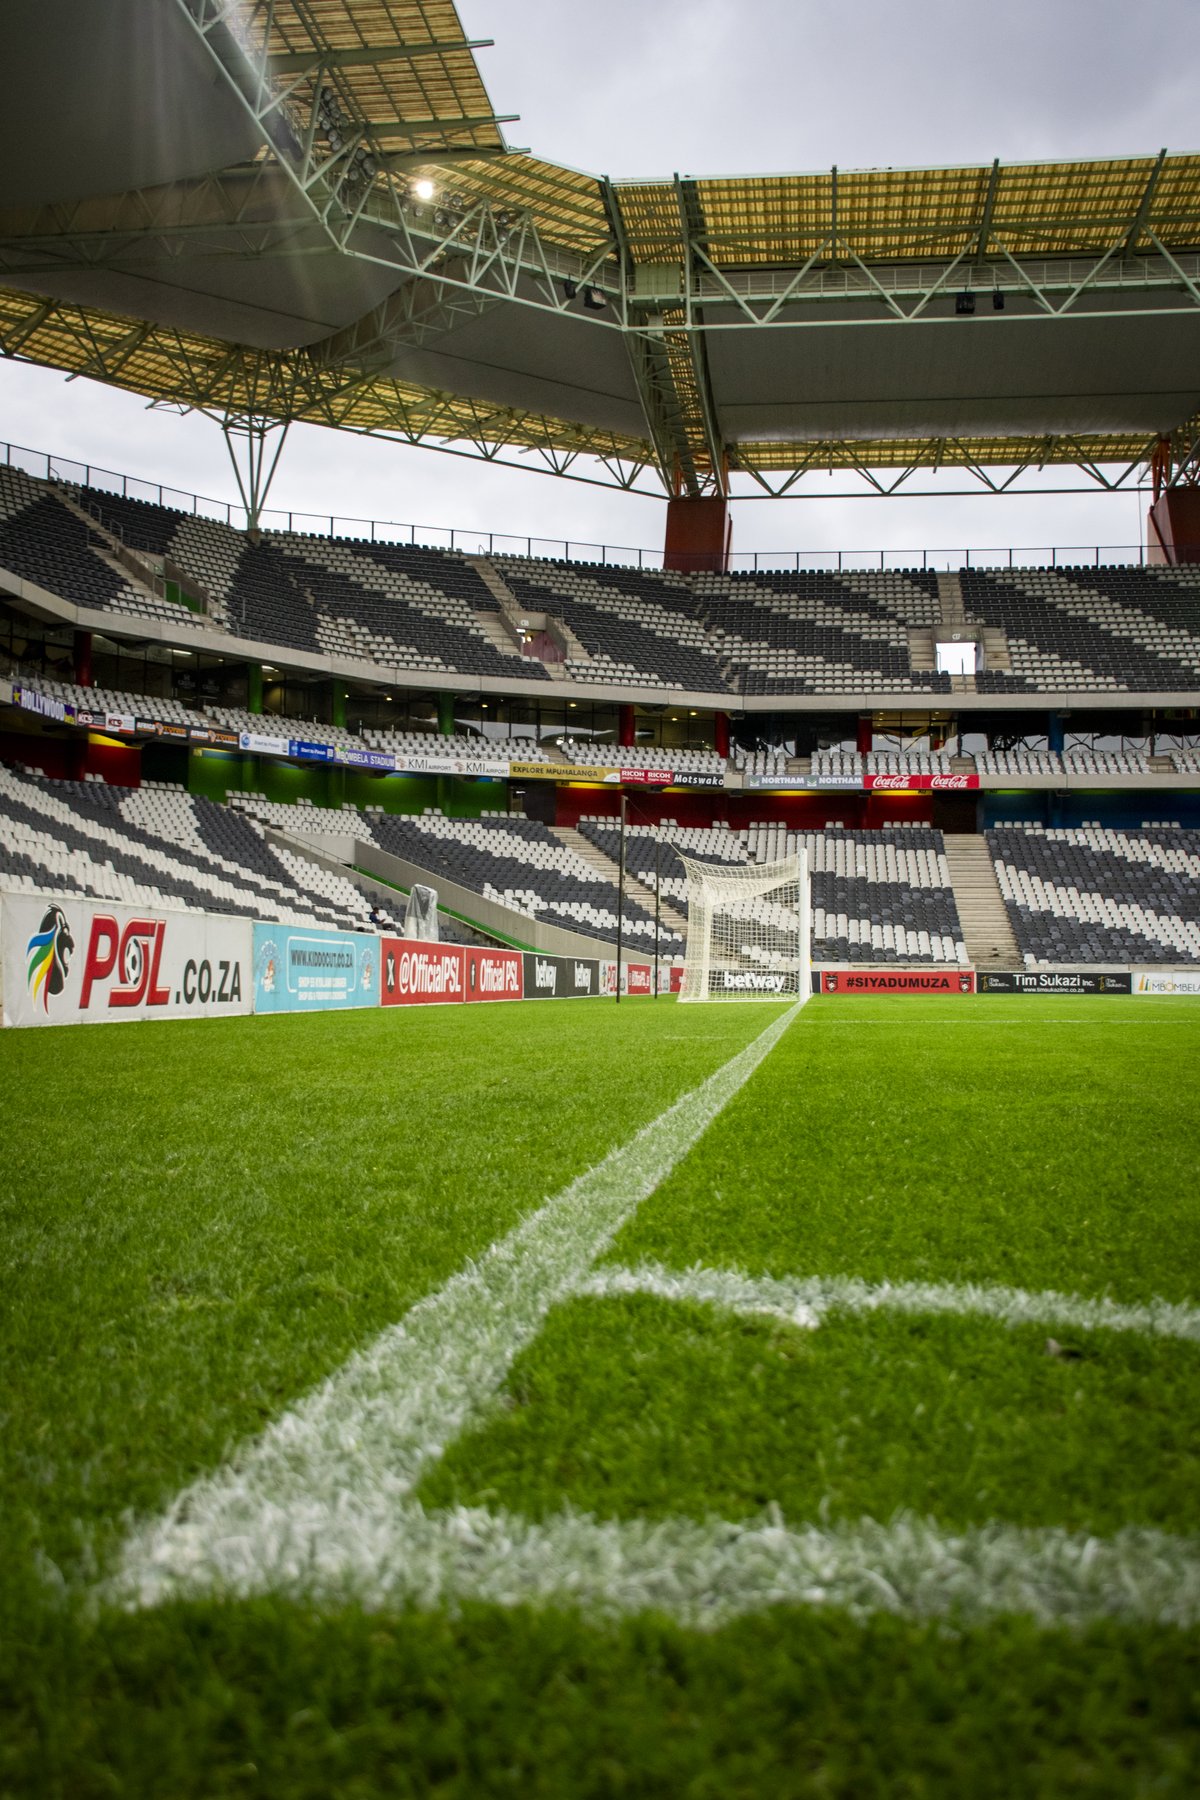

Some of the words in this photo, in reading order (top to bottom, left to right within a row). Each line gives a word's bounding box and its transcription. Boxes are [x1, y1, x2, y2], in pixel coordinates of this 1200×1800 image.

[21, 688, 65, 721] HOLLYWOOD
[370, 755, 396, 768] STADIUM
[513, 766, 544, 774] EXPLORE
[546, 769, 598, 777] MPUMALANGA
[674, 774, 724, 786] Motswako
[79, 913, 171, 1009] PSL
[399, 952, 461, 994] @OfficialPSL
[480, 958, 505, 992] Official
[505, 960, 519, 991] PSL
[724, 971, 785, 992] betway
[1013, 974, 1037, 986] Tim
[1039, 974, 1080, 986] Sukazi
[846, 977, 950, 988] #SIYADUMUZA
